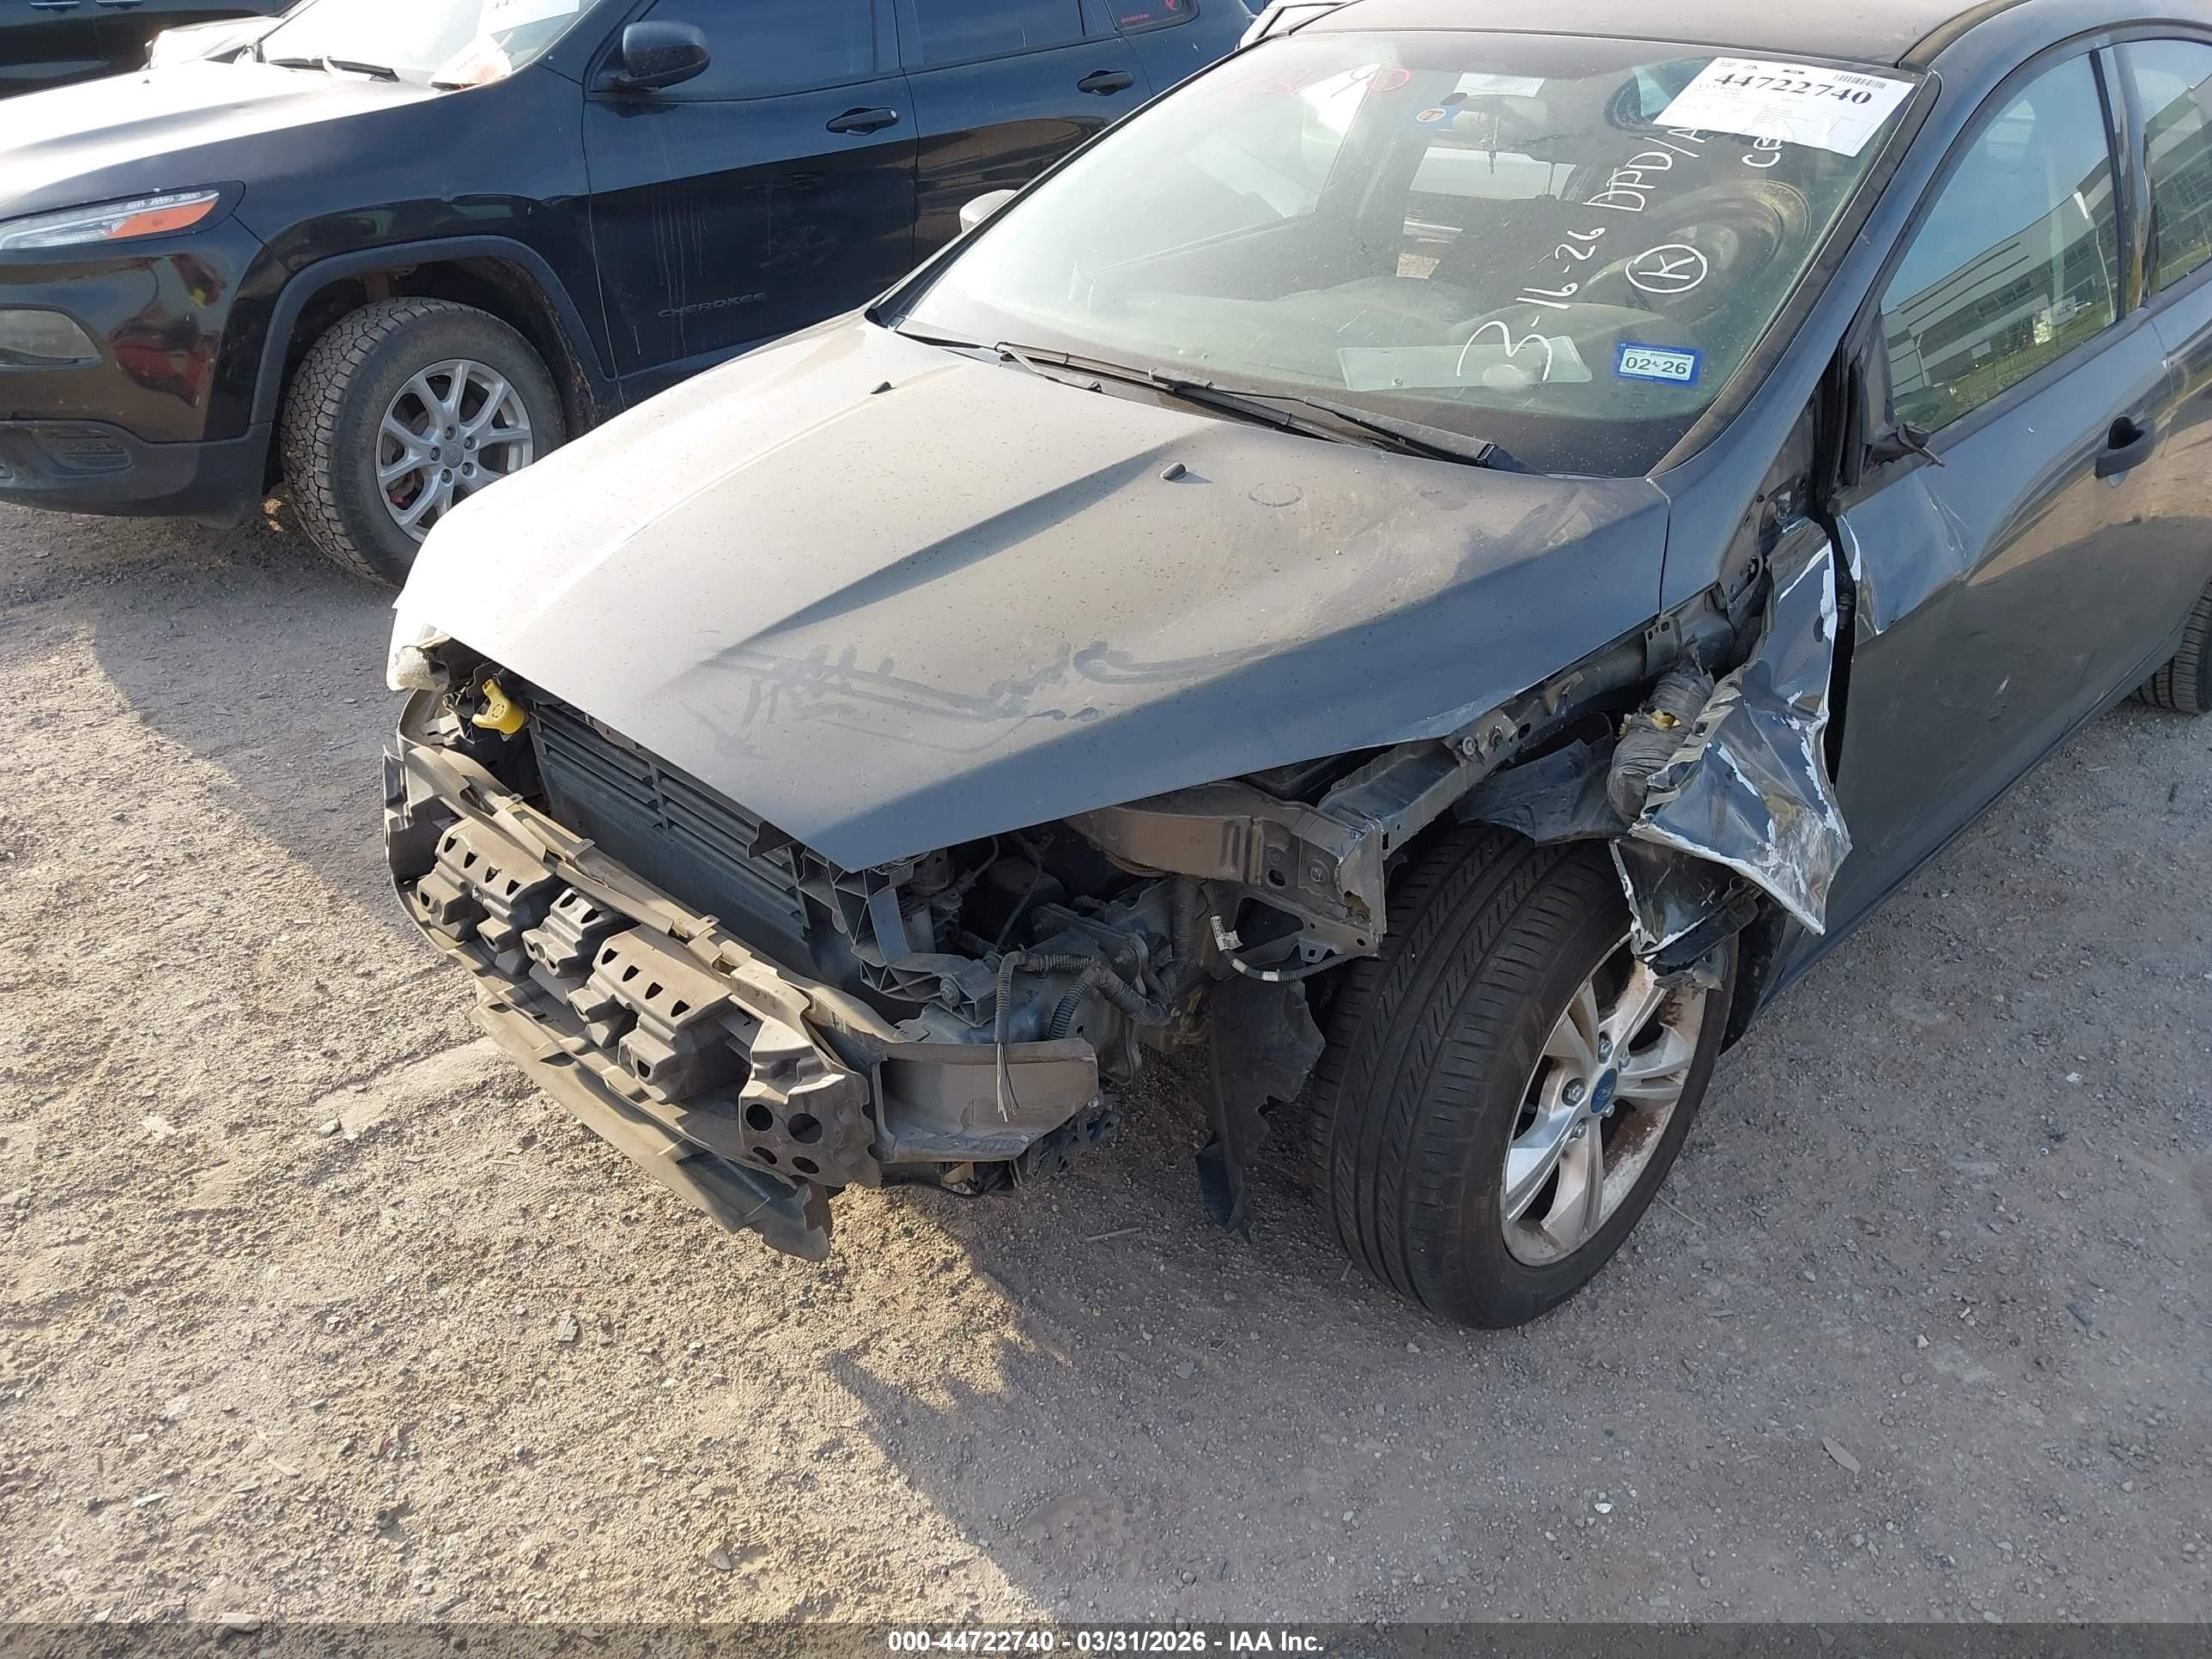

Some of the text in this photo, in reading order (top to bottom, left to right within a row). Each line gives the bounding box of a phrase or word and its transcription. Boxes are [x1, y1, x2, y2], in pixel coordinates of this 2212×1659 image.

[1714, 73, 1872, 105] 44722740
[658, 293, 766, 317] CHEROKEE
[1626, 356, 1687, 374] 02 26
